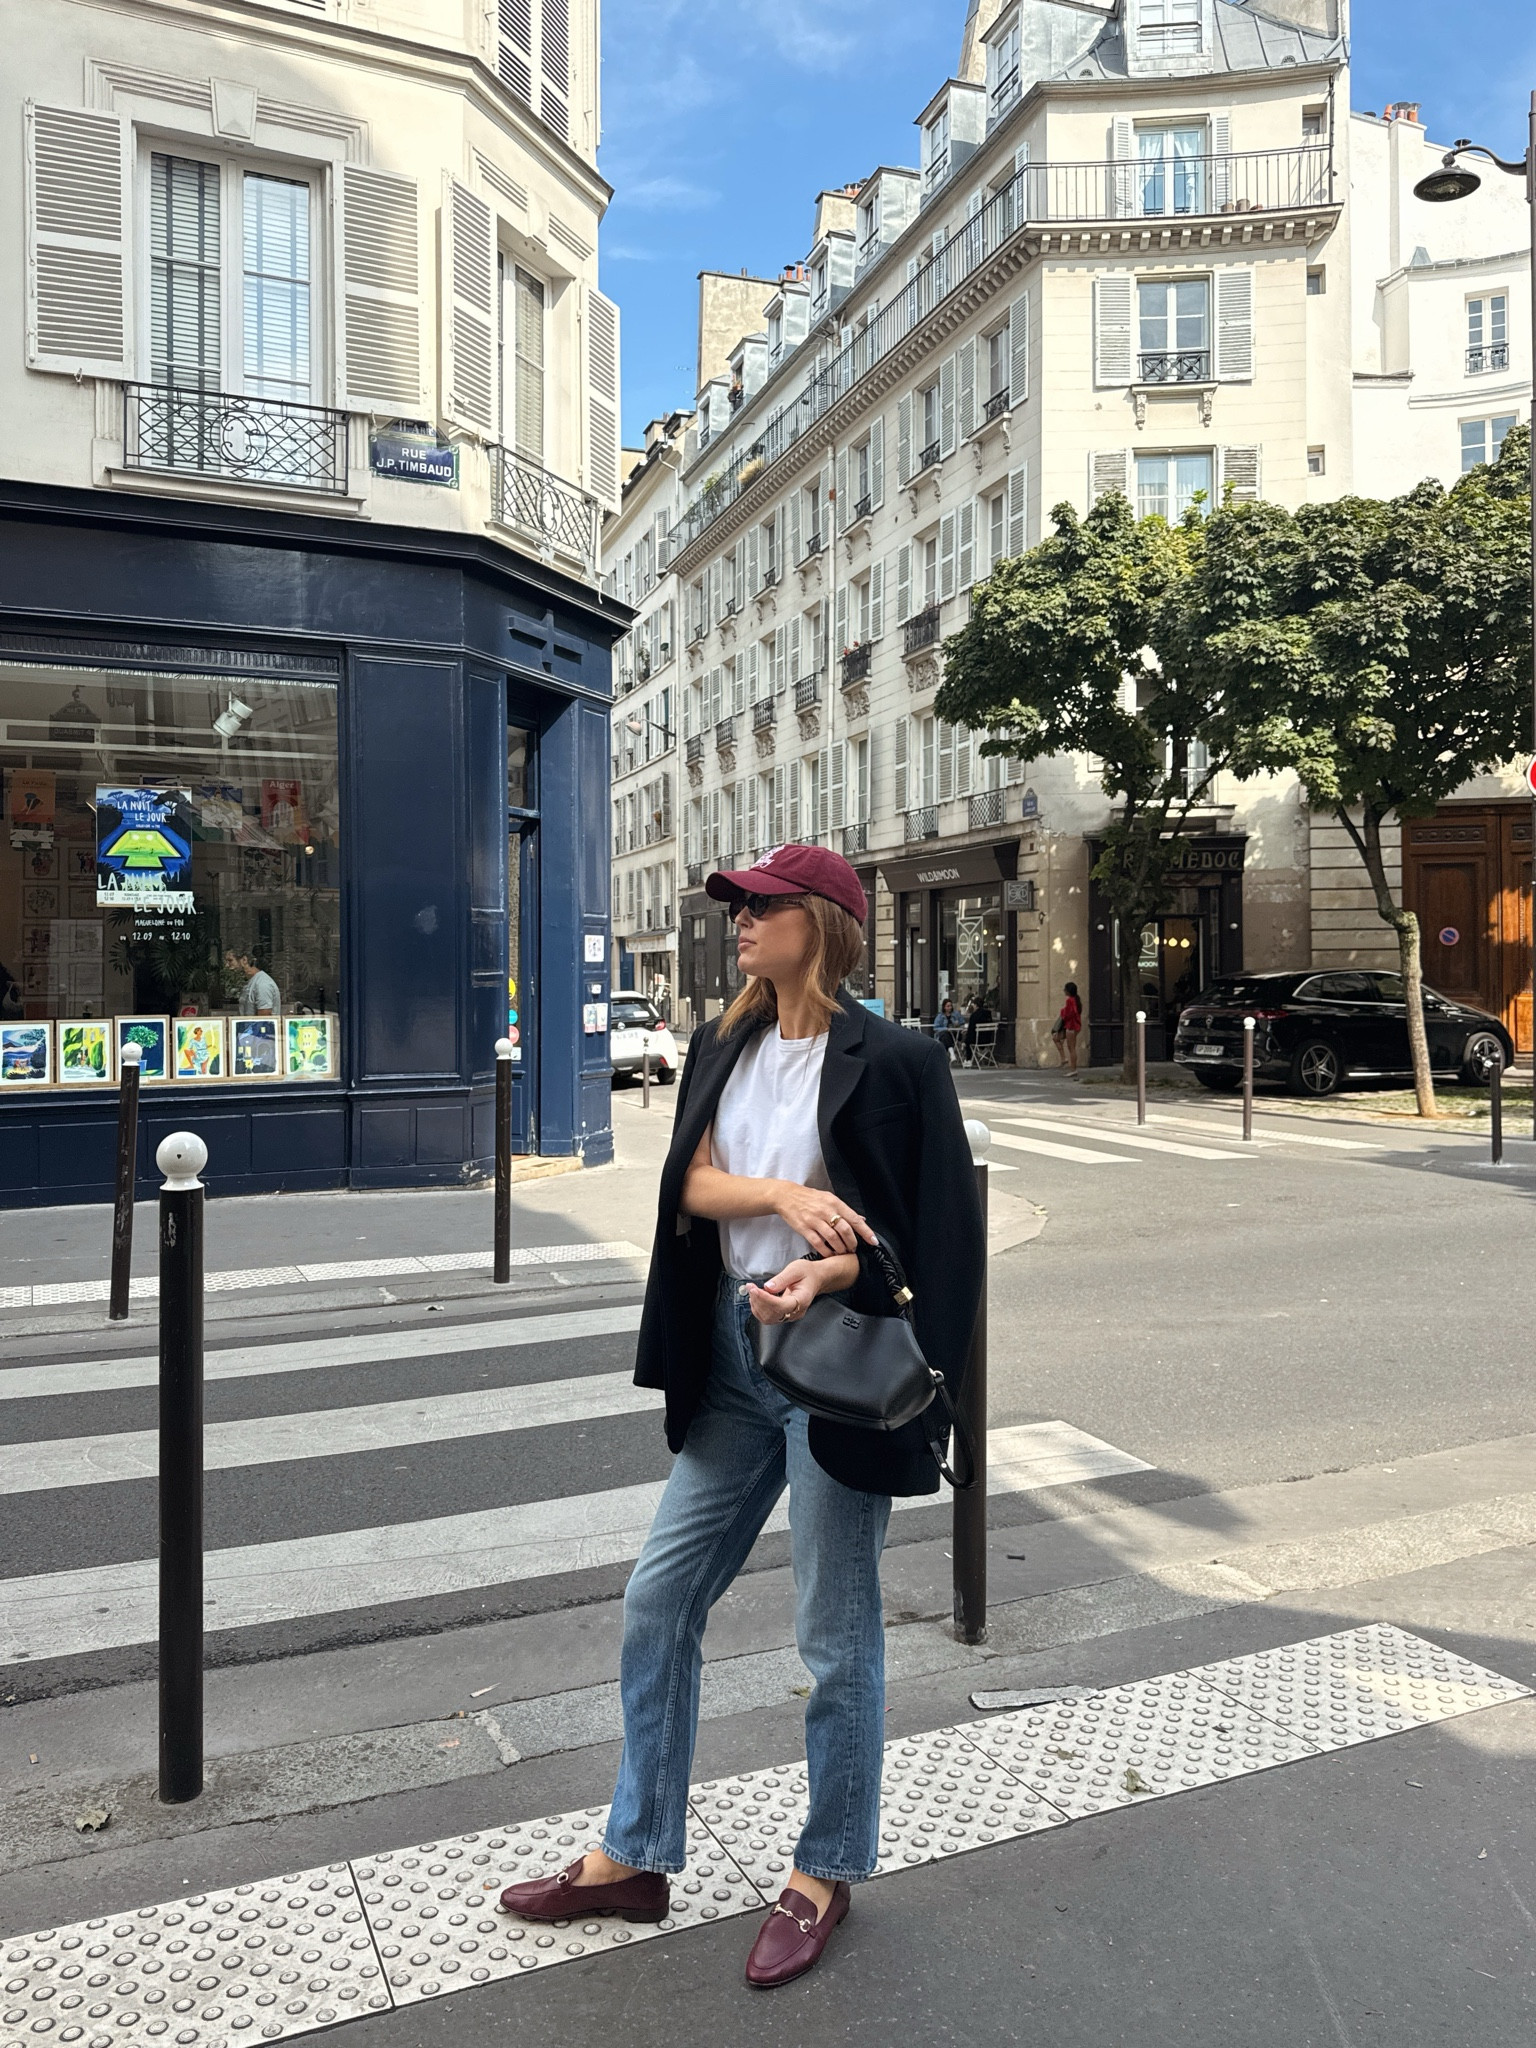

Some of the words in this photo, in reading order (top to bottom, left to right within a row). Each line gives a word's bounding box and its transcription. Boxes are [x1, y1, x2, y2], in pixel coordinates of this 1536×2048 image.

[401, 447, 427, 460] RUE
[398, 460, 452, 477] TIMBAUD
[269, 781, 295, 790] Alger
[117, 800, 128, 811] LA
[130, 799, 151, 811] NUIT
[134, 812, 144, 821] LE
[97, 872, 118, 892] LA
[134, 895, 152, 913] LE
